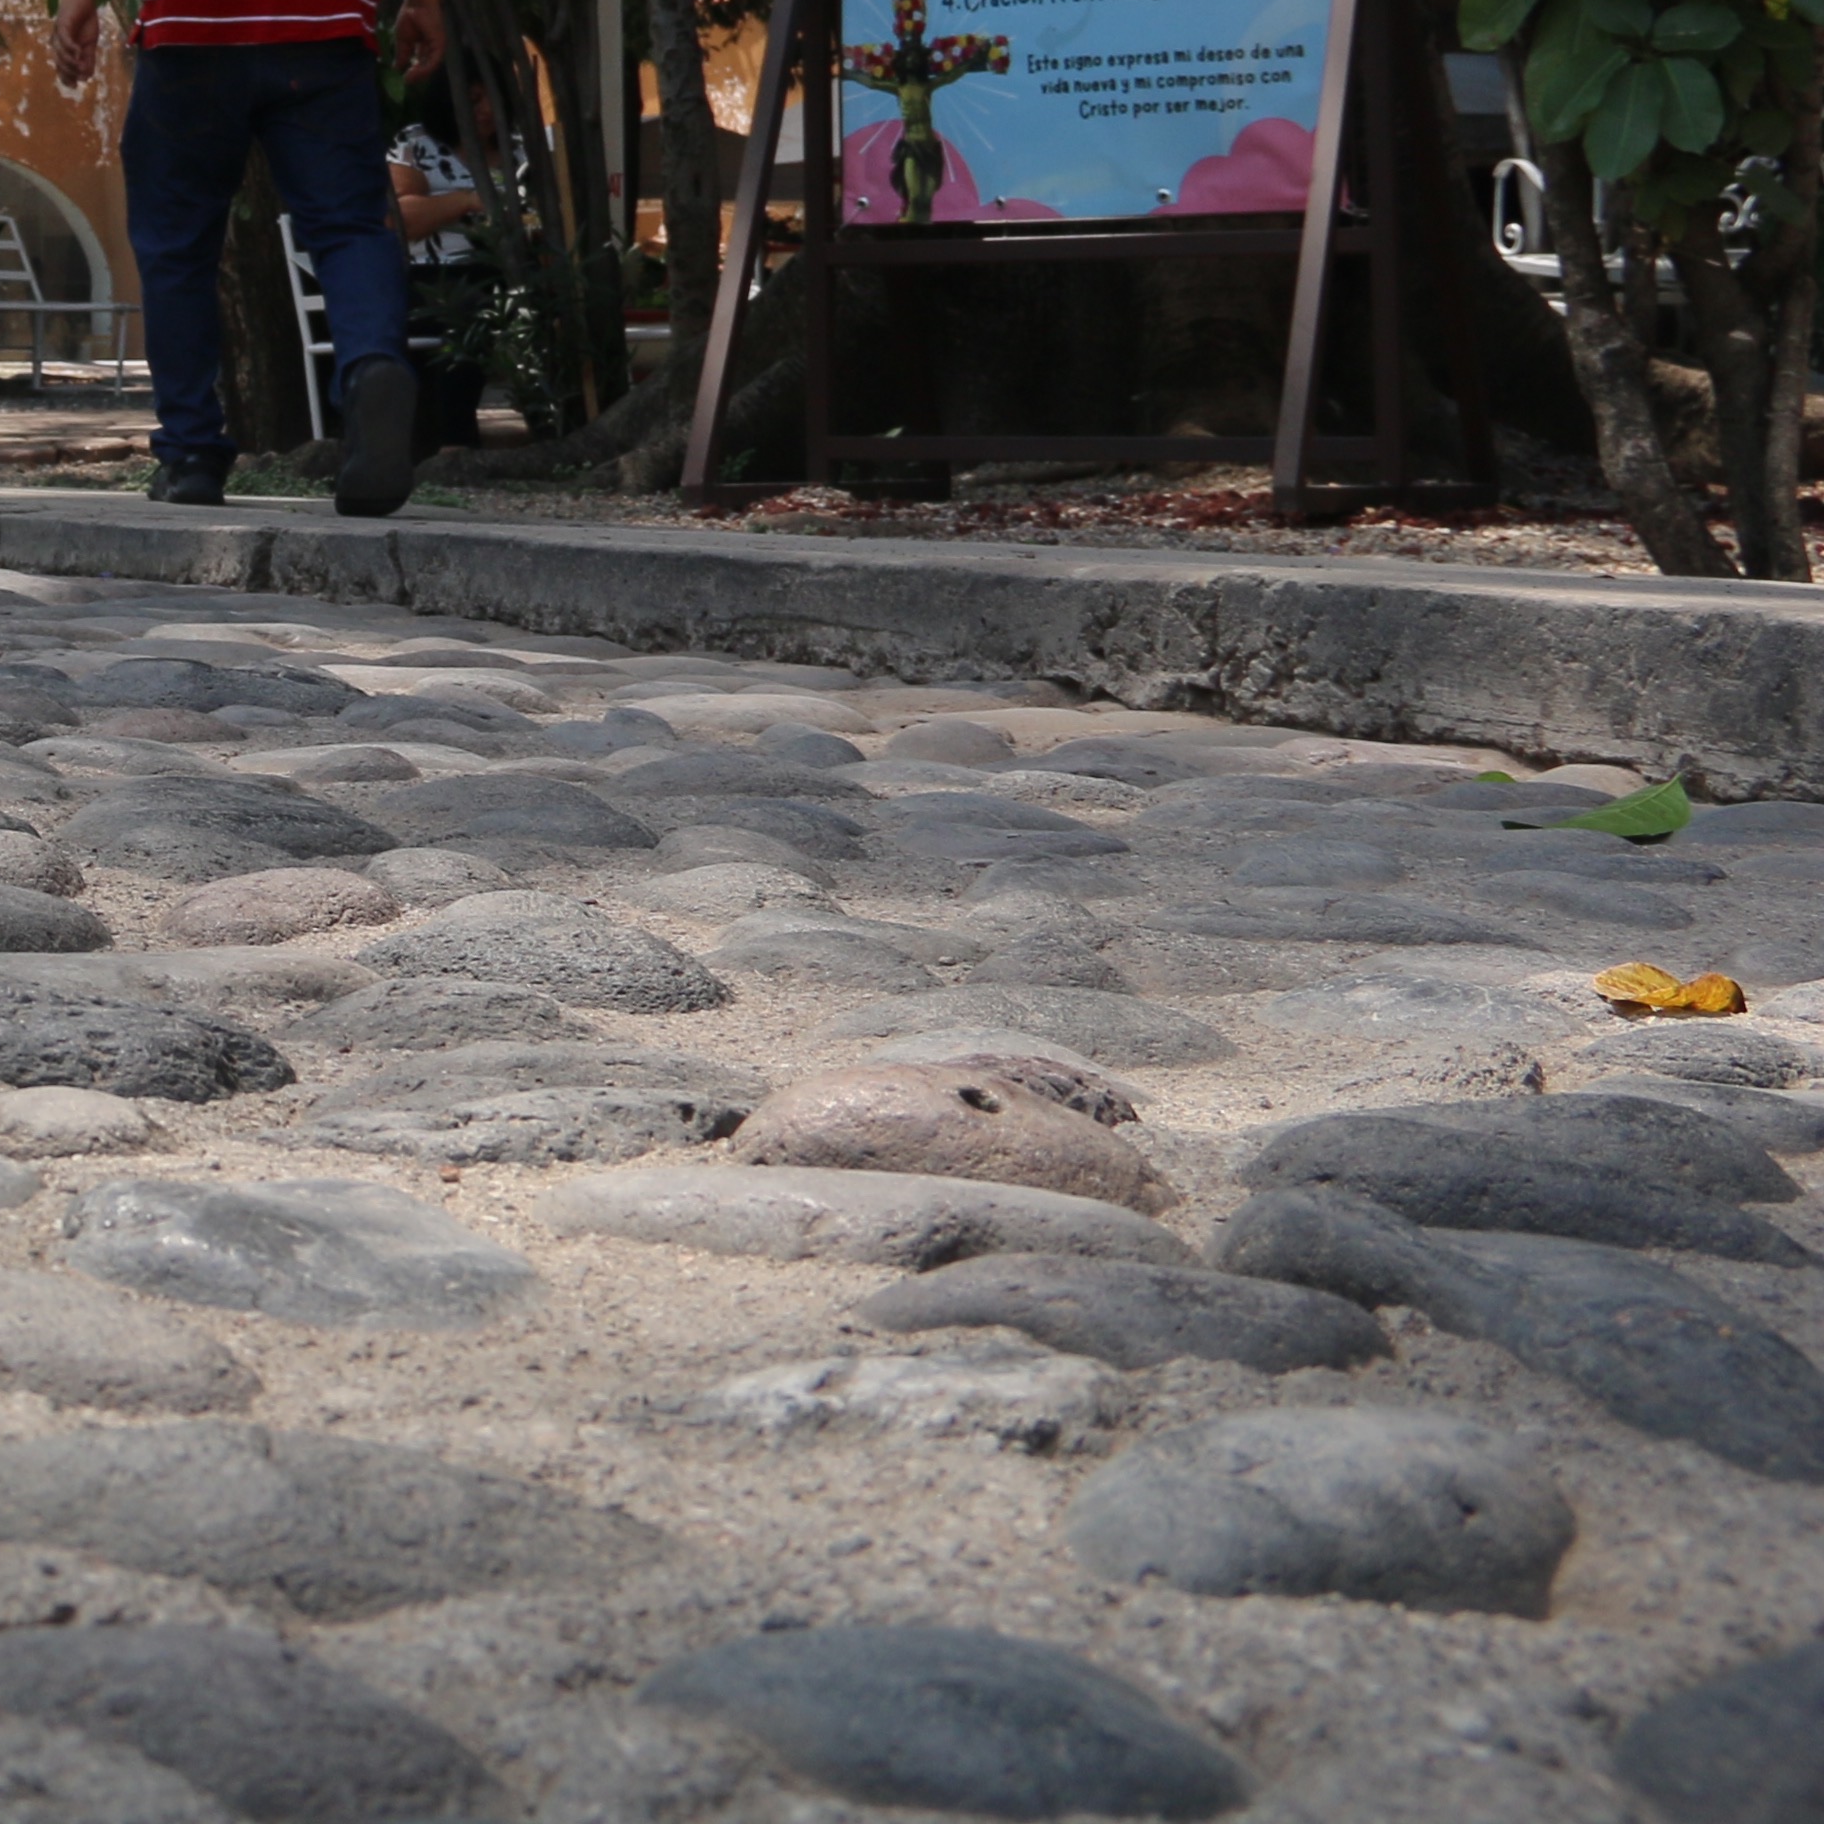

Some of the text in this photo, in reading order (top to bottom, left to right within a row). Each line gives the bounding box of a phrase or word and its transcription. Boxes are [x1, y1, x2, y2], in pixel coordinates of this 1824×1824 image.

[1027, 42, 1306, 74] Este signo expresa mi deseo de una
[1040, 69, 1293, 95] vida nueva y mi compromiso con
[1078, 96, 1250, 119] Cristo por ser mejor.
